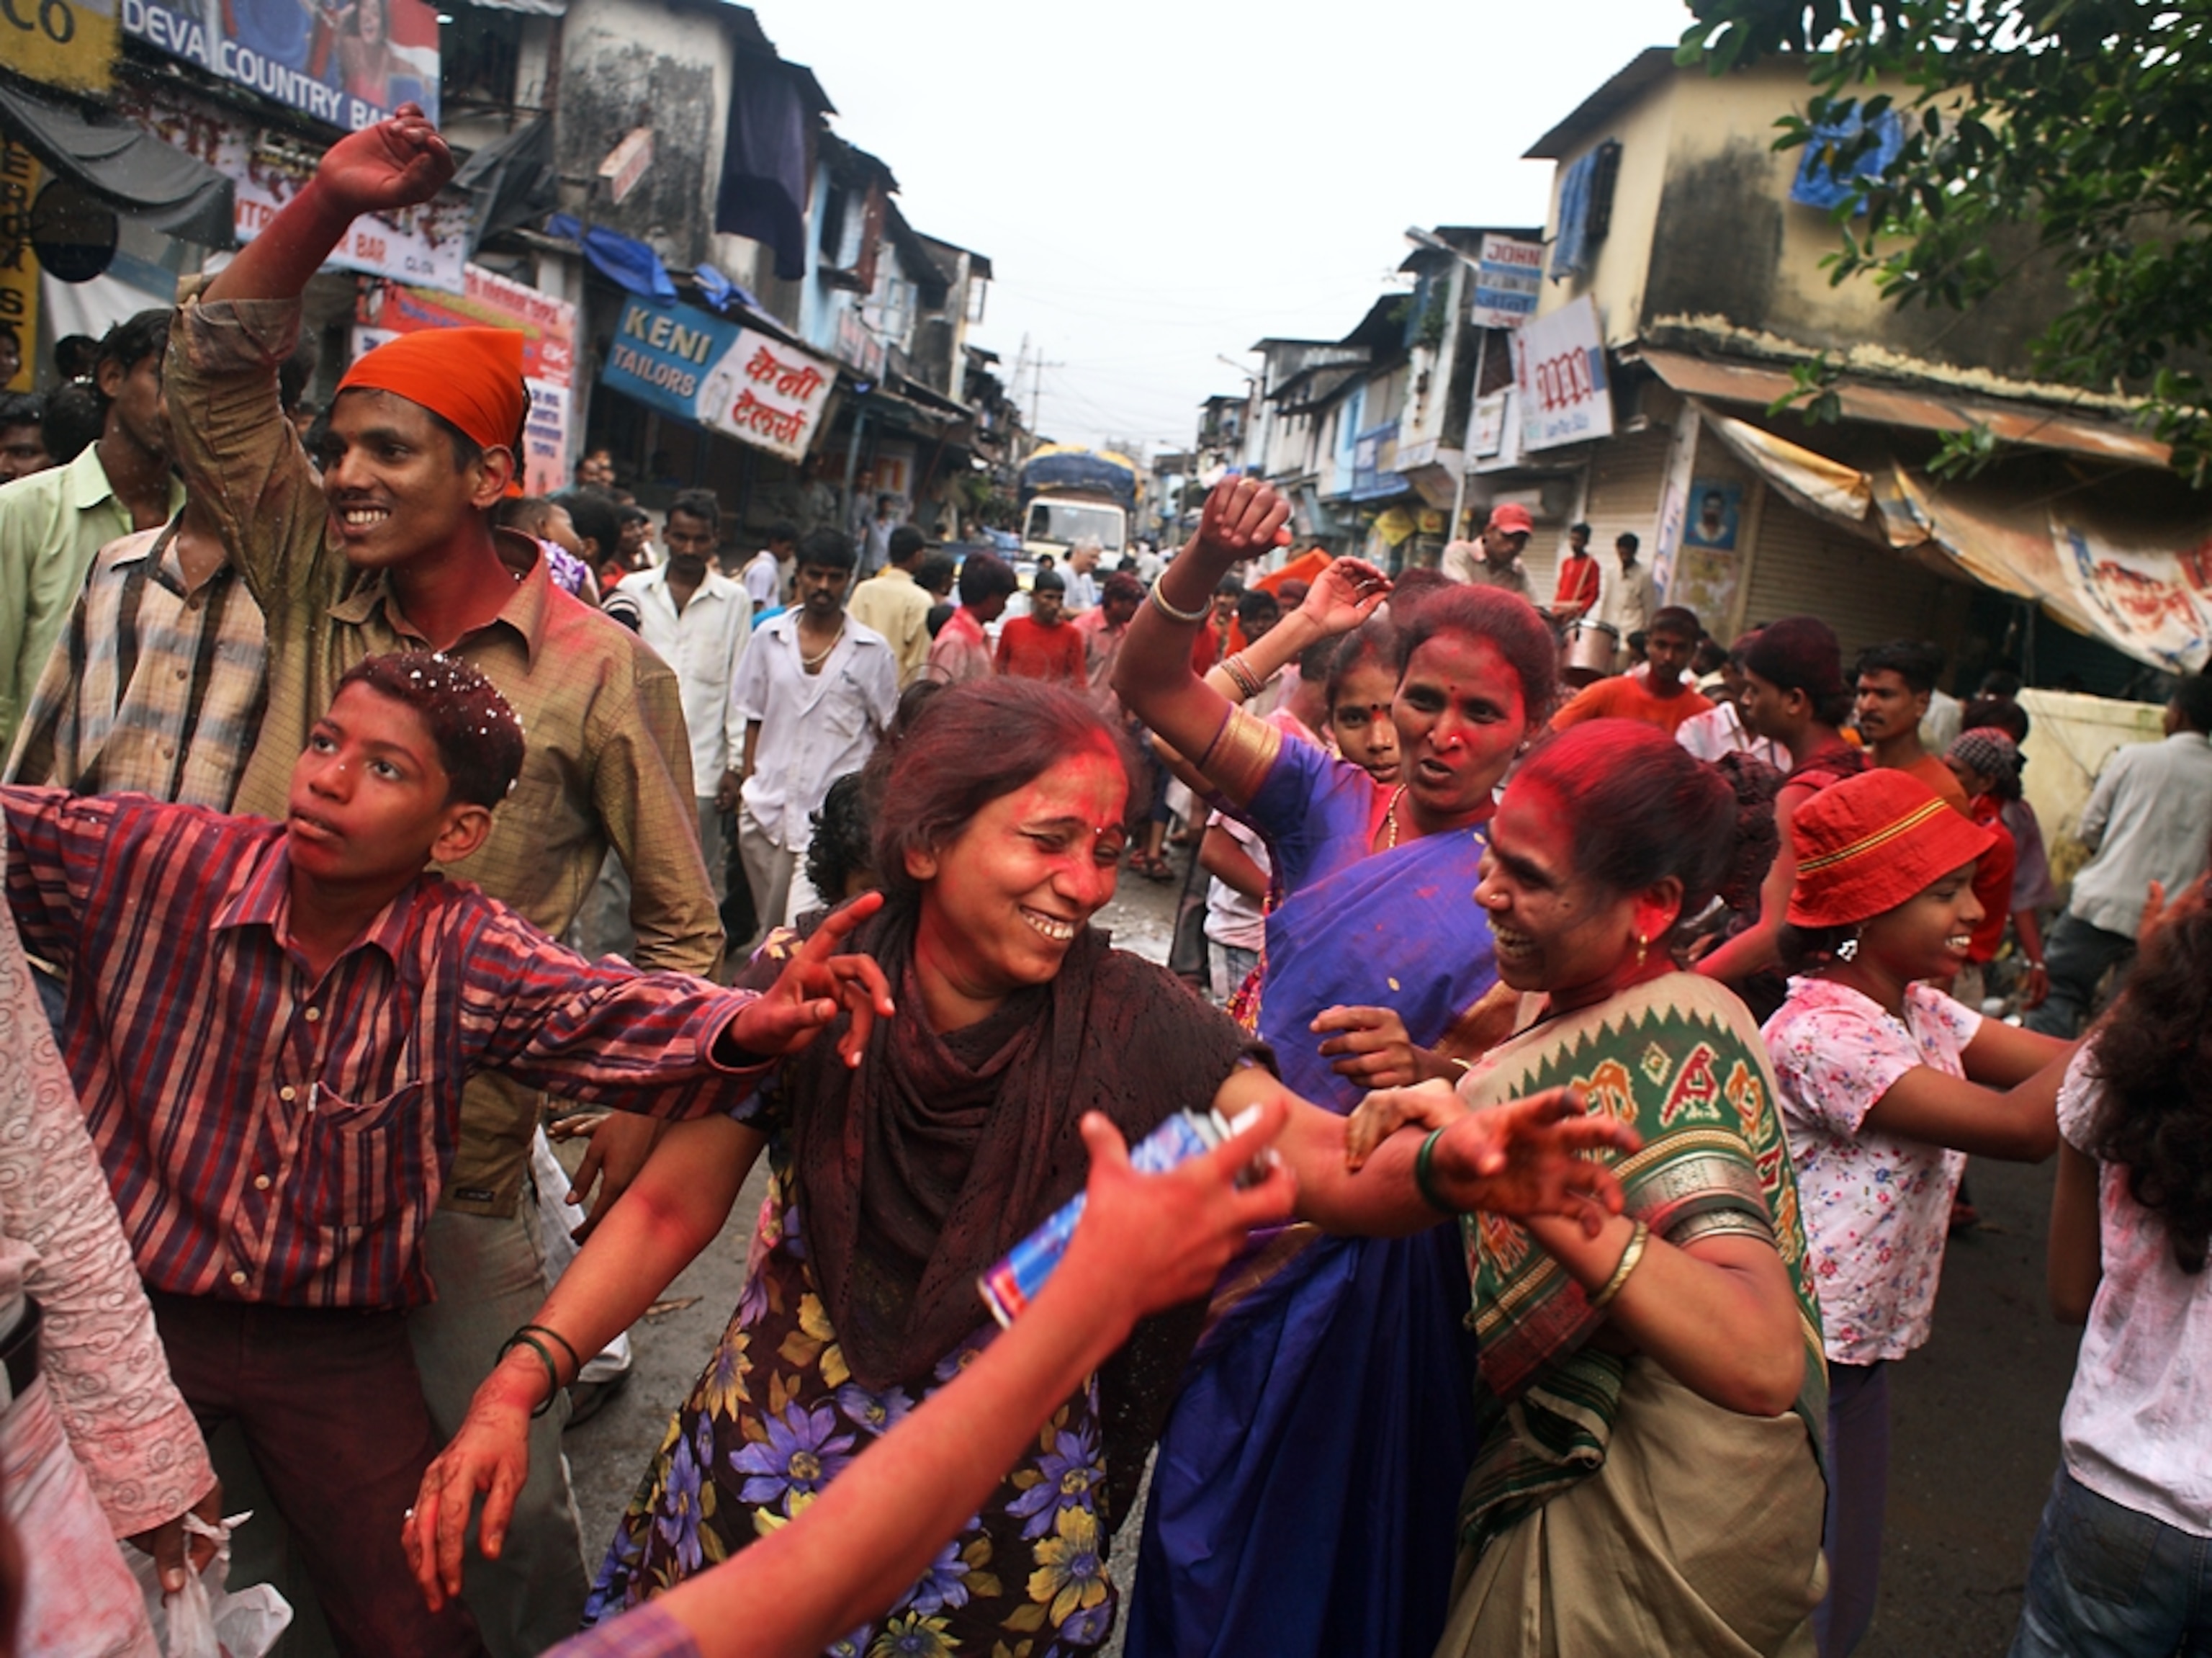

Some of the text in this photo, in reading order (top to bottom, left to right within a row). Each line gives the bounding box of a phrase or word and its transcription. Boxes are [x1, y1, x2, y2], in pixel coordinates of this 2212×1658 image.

[122, 0, 396, 131] DEVA COUNTRY BA
[356, 232, 385, 264] BAR
[1487, 243, 1539, 266] JOHN
[624, 305, 714, 366] KENI
[614, 344, 697, 398] TAILORS
[745, 345, 827, 400] केनी
[732, 387, 807, 444] टेलर्स
